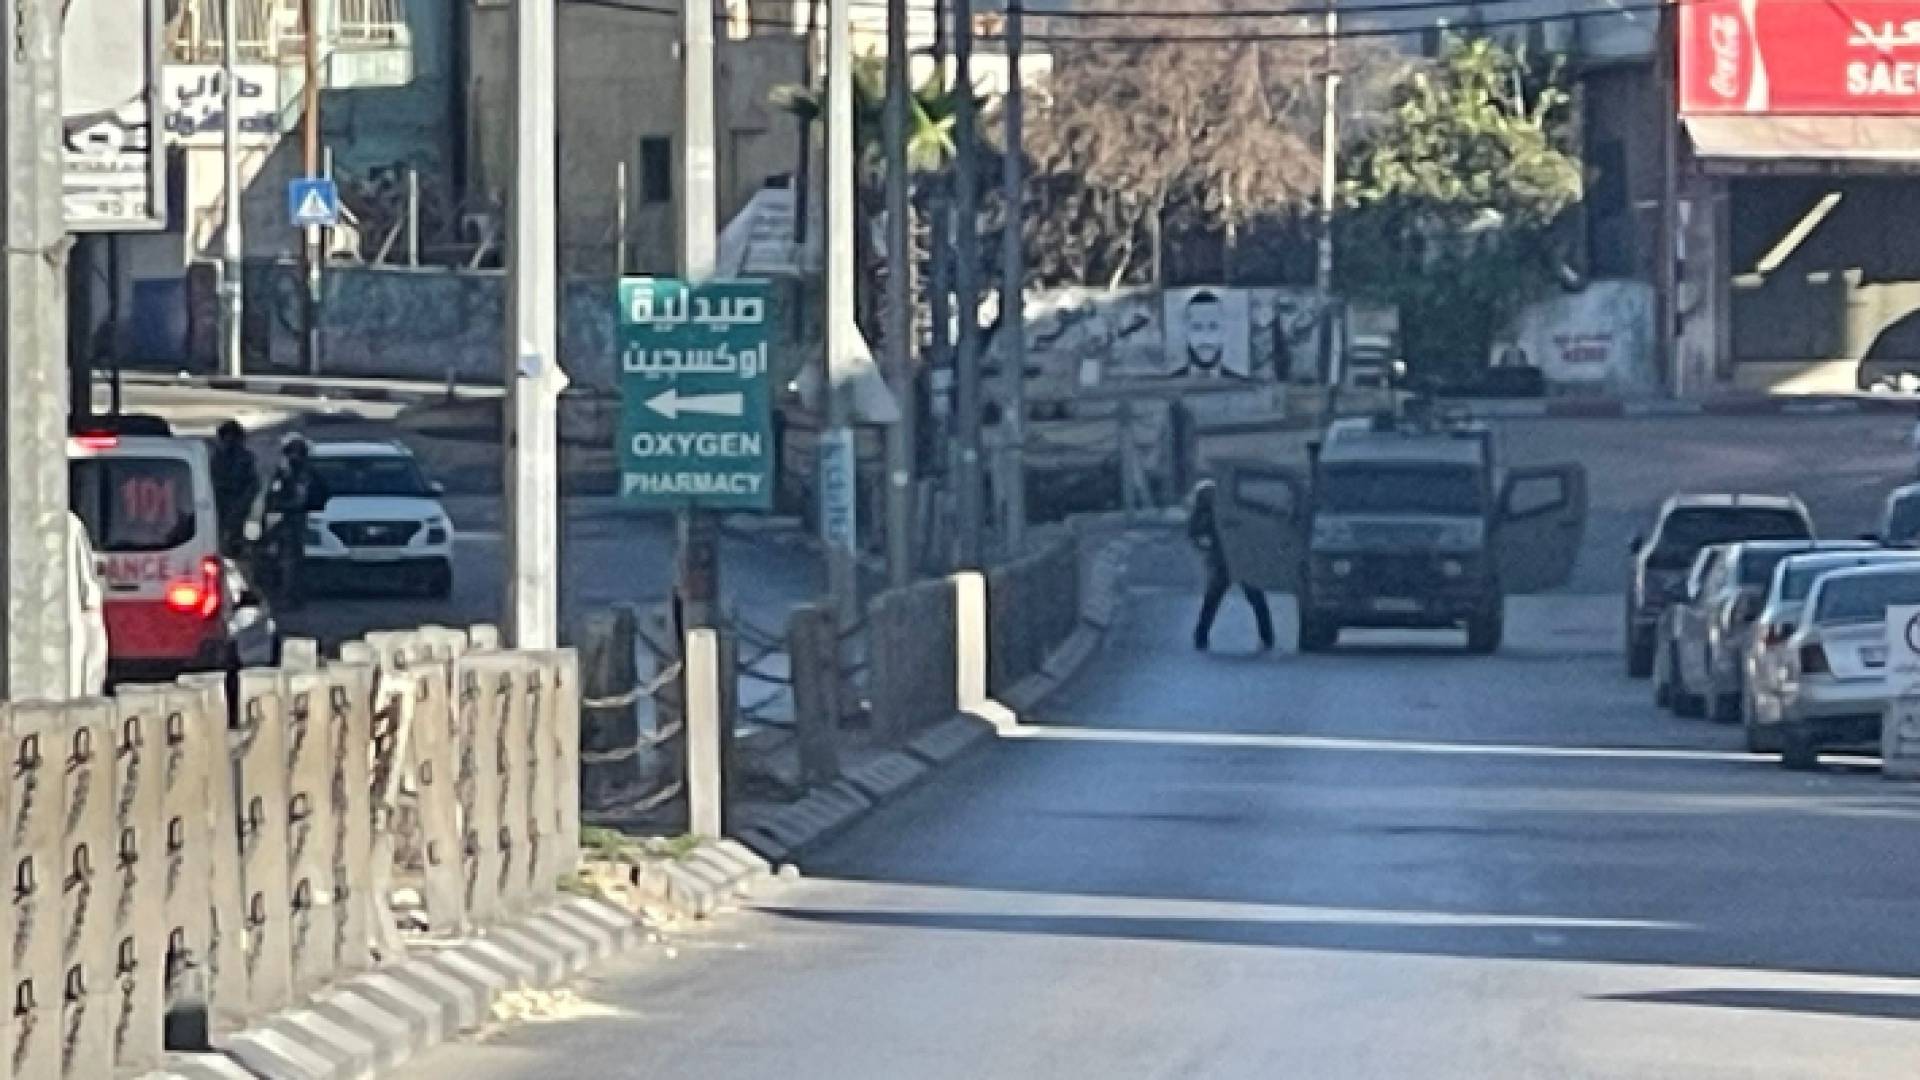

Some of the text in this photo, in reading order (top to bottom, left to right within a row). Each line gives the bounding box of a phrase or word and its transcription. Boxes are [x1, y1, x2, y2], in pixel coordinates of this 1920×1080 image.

[1846, 61, 1920, 95] SAE
[631, 287, 764, 332] صيدلية
[623, 341, 768, 380] اوكسجين
[631, 431, 762, 457] OXYGEN
[623, 472, 763, 495] PHARMACY
